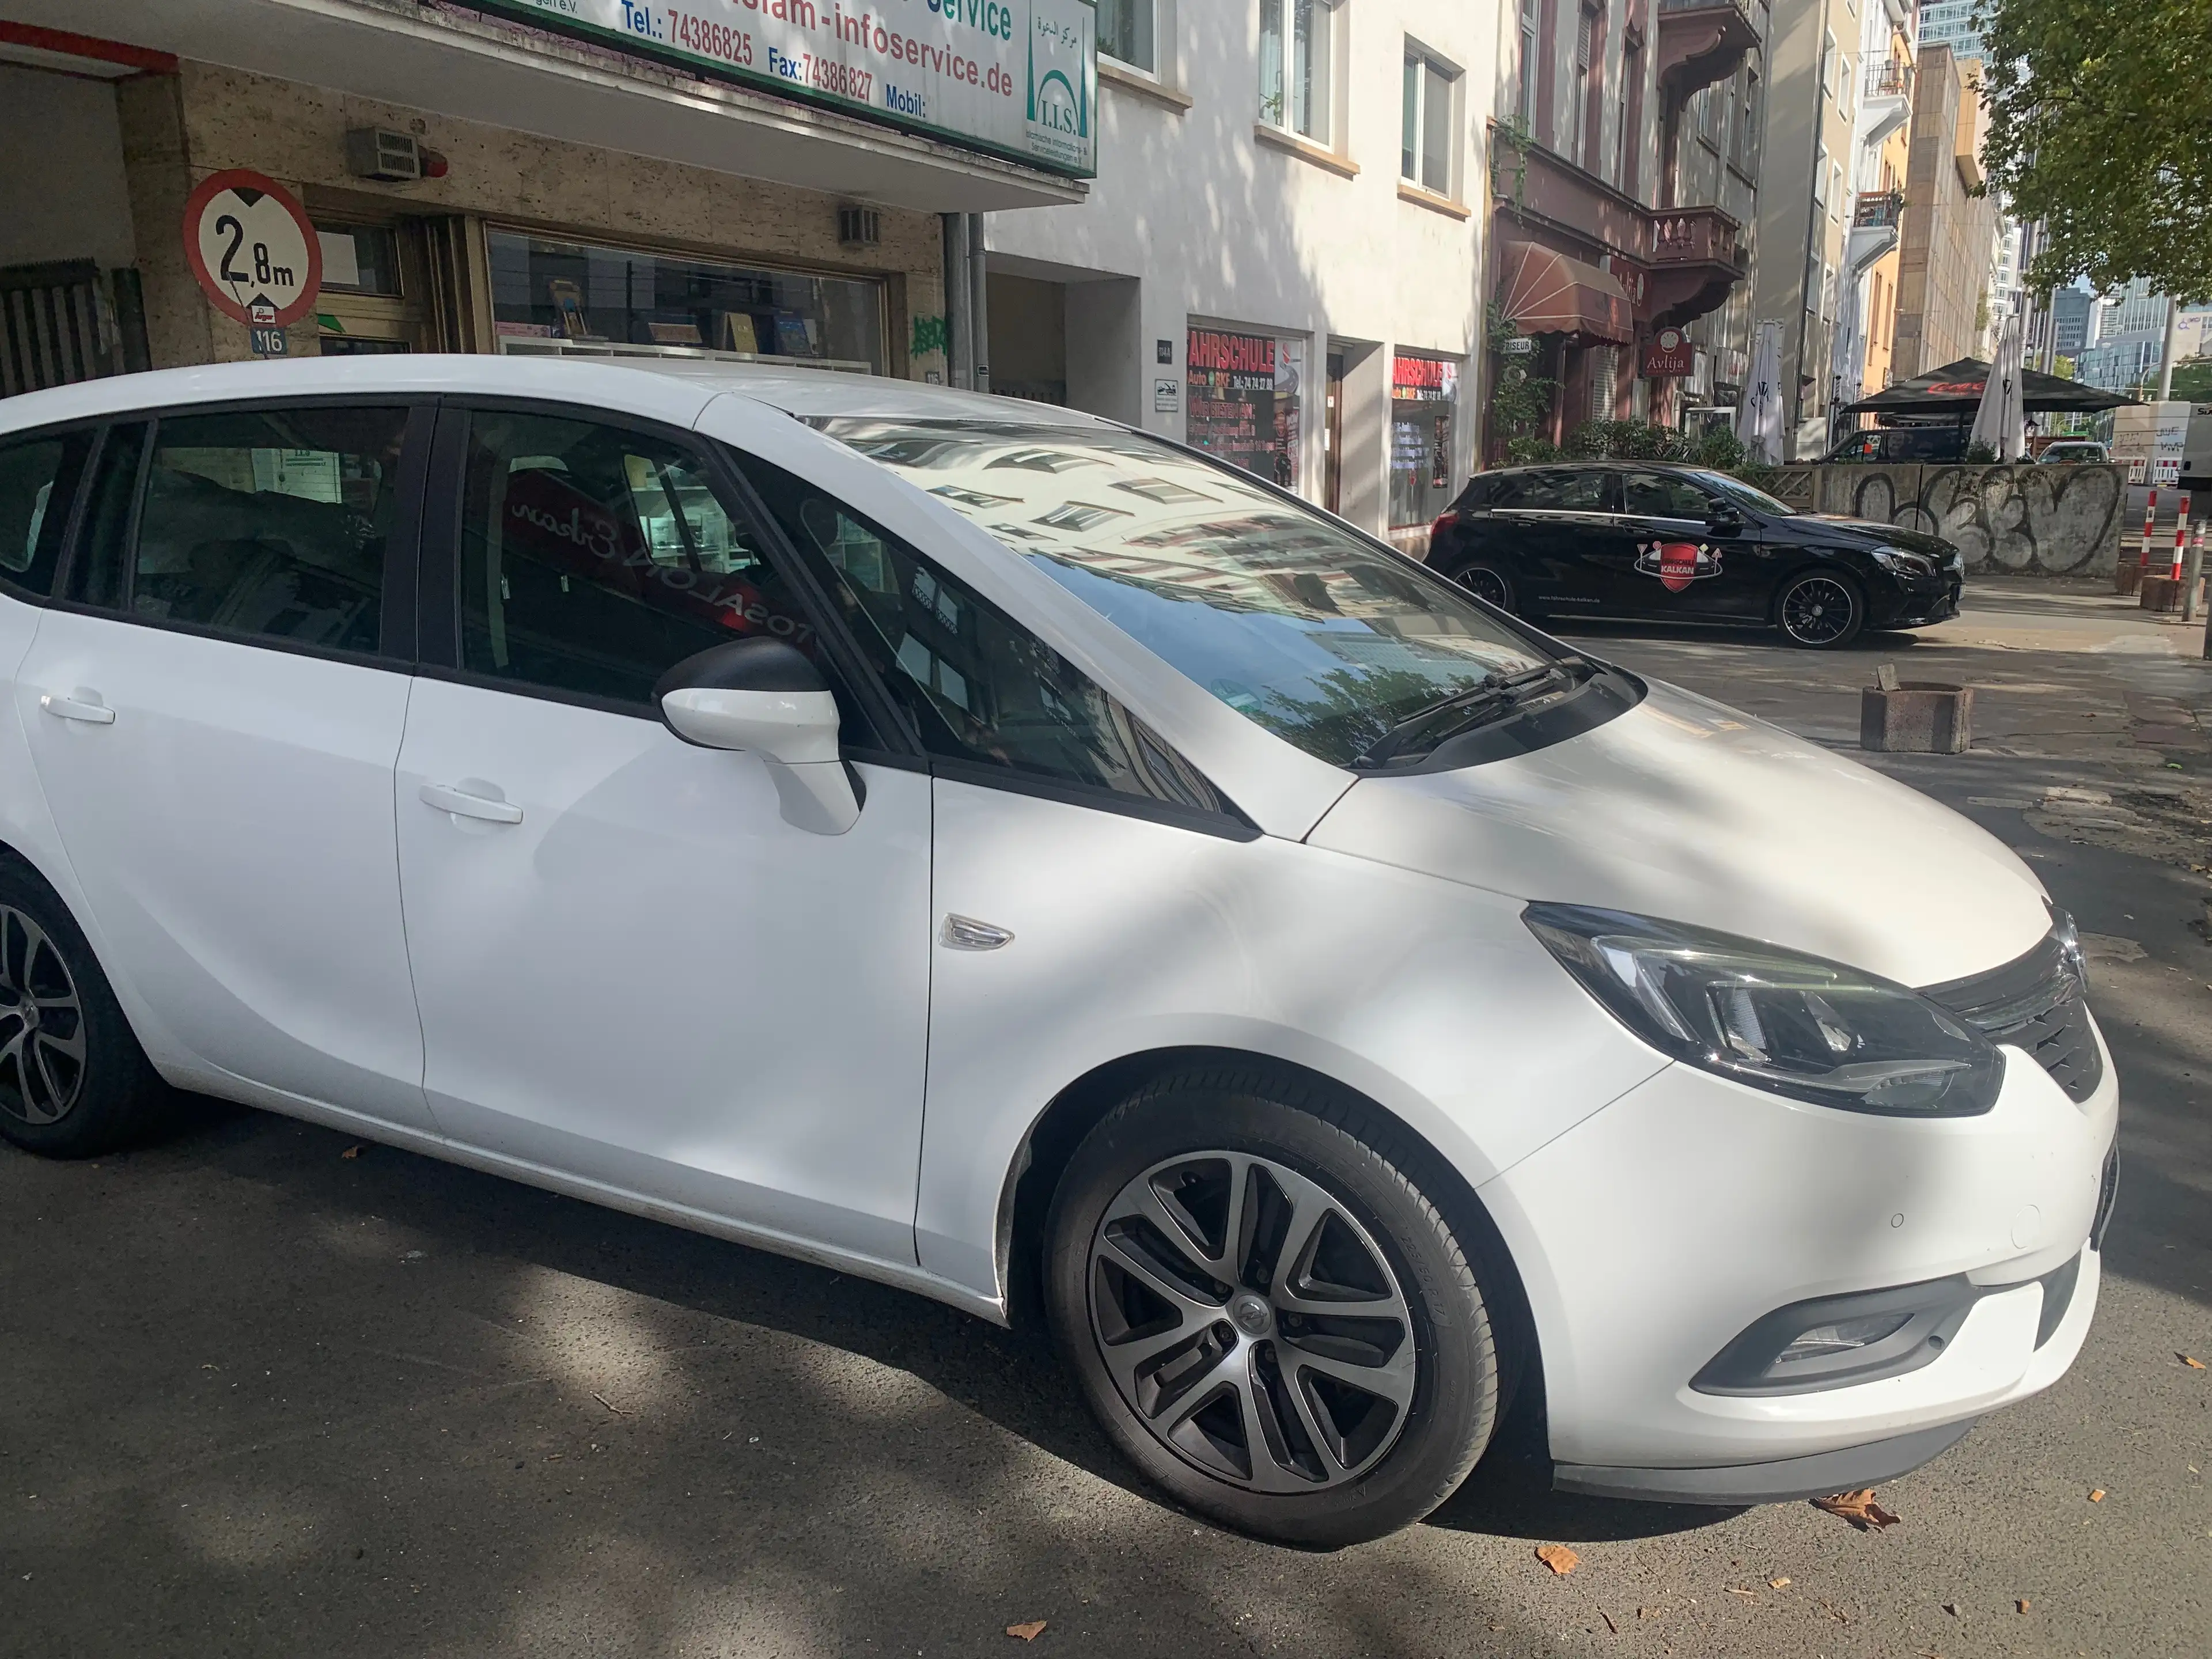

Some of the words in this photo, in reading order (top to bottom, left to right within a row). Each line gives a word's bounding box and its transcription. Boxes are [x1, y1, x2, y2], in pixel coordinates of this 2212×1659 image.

[668, 9, 753, 66] 74386825
[885, 84, 926, 118] Mobil:
[1619, 271, 1637, 304] lija
[1504, 341, 1529, 351] RISEUR
[1647, 355, 1684, 373] Avlija
[1188, 369, 1207, 385] Auto
[1215, 371, 1231, 388] BKF
[1661, 565, 1694, 574] KALKAN
[1400, 1236, 1433, 1284] 225/50
